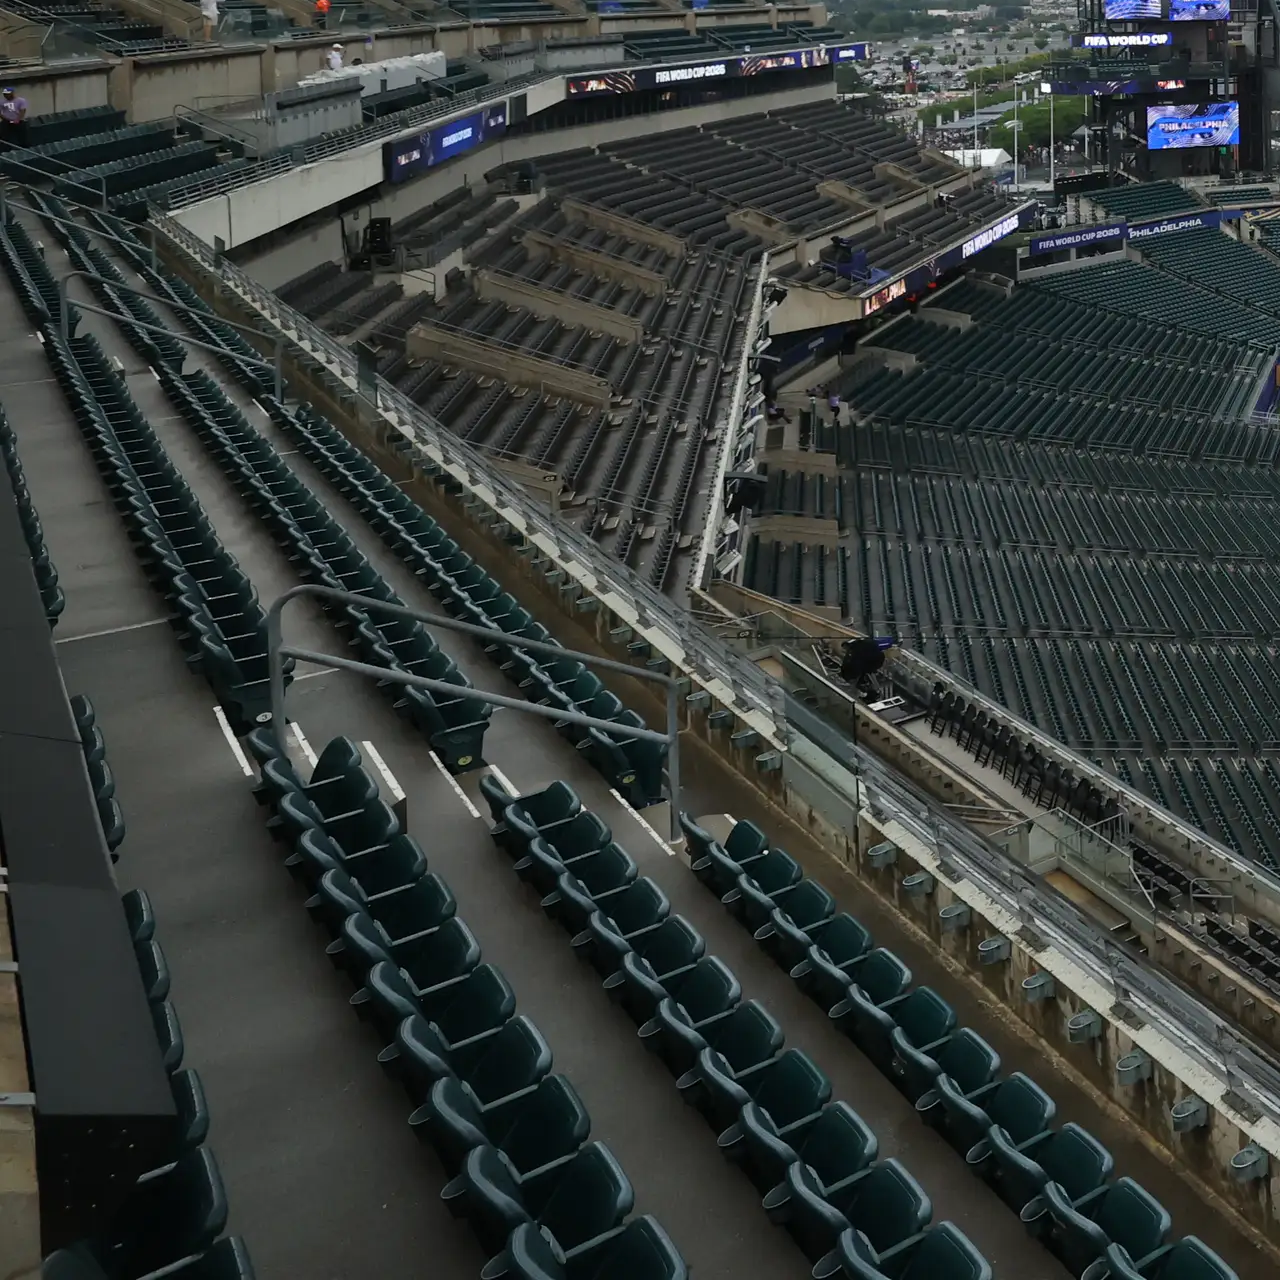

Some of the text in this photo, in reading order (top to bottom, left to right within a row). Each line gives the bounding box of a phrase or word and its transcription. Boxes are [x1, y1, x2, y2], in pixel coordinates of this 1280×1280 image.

[1084, 34, 1168, 47] FIFA WORLD CUP
[655, 64, 726, 83] FIFA WORLD CUP 2026
[962, 214, 1019, 259] FIFA WORLD CUP 2026
[1039, 227, 1121, 251] FIFA WORLD CUP 2026
[1128, 218, 1202, 239] PHILADELPHIA
